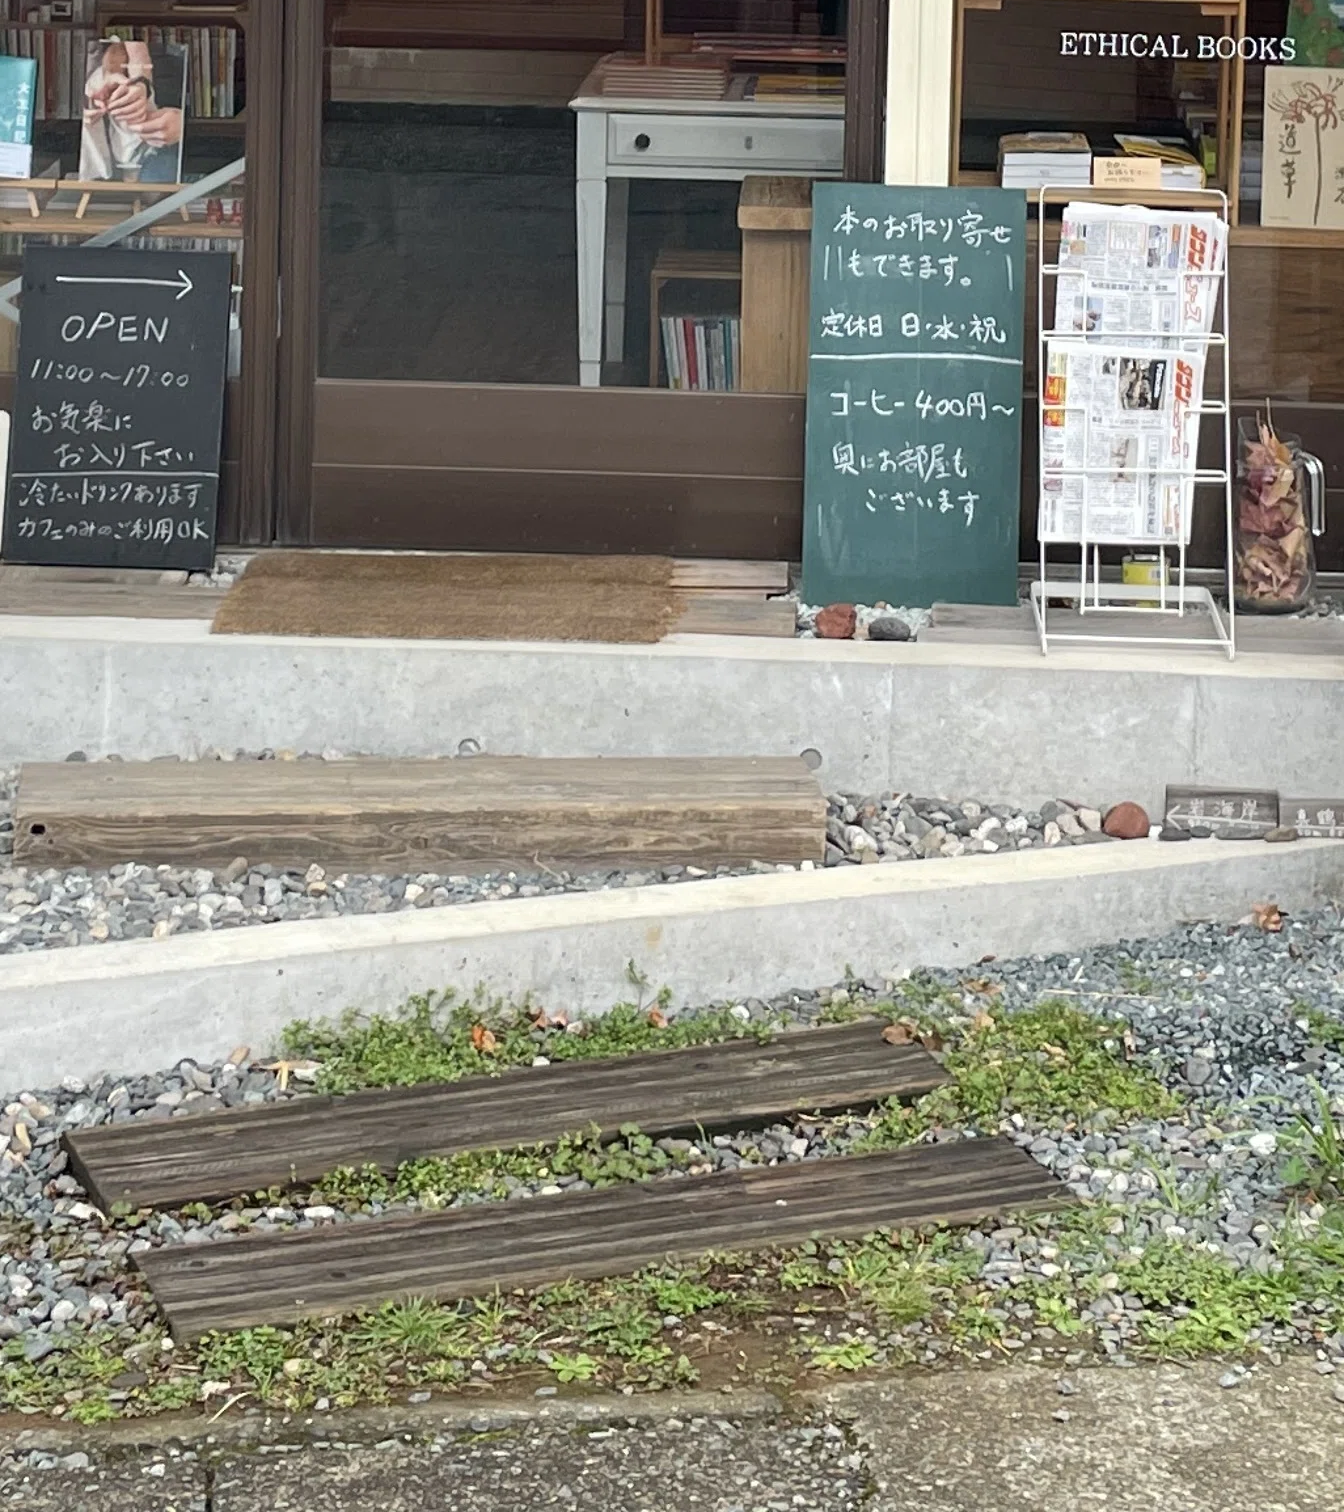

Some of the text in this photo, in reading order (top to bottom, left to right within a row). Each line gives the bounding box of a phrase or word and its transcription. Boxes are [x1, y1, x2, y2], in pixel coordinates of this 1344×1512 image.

[1058, 31, 1297, 62] ETHICAL BOOKS
[833, 207, 1013, 248] 本のお取り寄せ
[60, 310, 171, 344] OPEN
[819, 312, 883, 339] 定休日
[54, 440, 195, 469] お入り下さい
[864, 489, 981, 528] ございます
